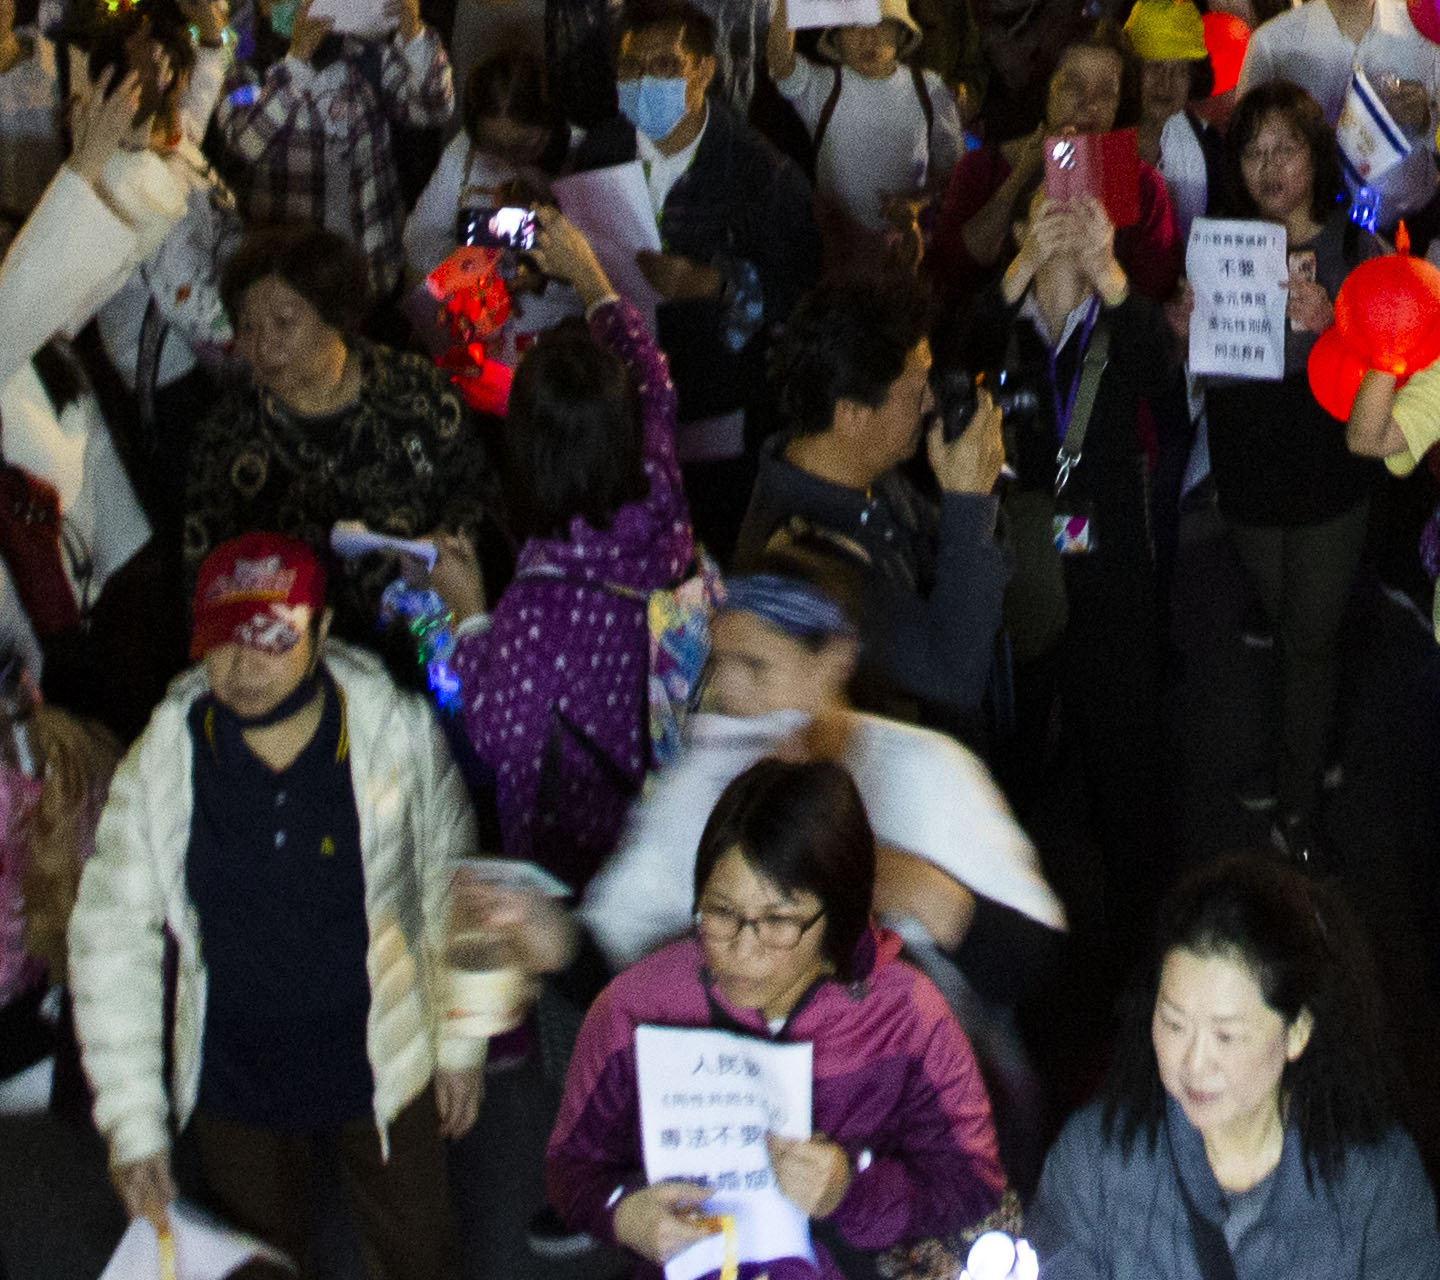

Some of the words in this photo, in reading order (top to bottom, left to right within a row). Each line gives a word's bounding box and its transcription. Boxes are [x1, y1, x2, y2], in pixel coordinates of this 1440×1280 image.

[1219, 258, 1256, 278] 不要
[1214, 342, 1266, 361] 同志教育
[692, 1053, 761, 1077] 人民要
